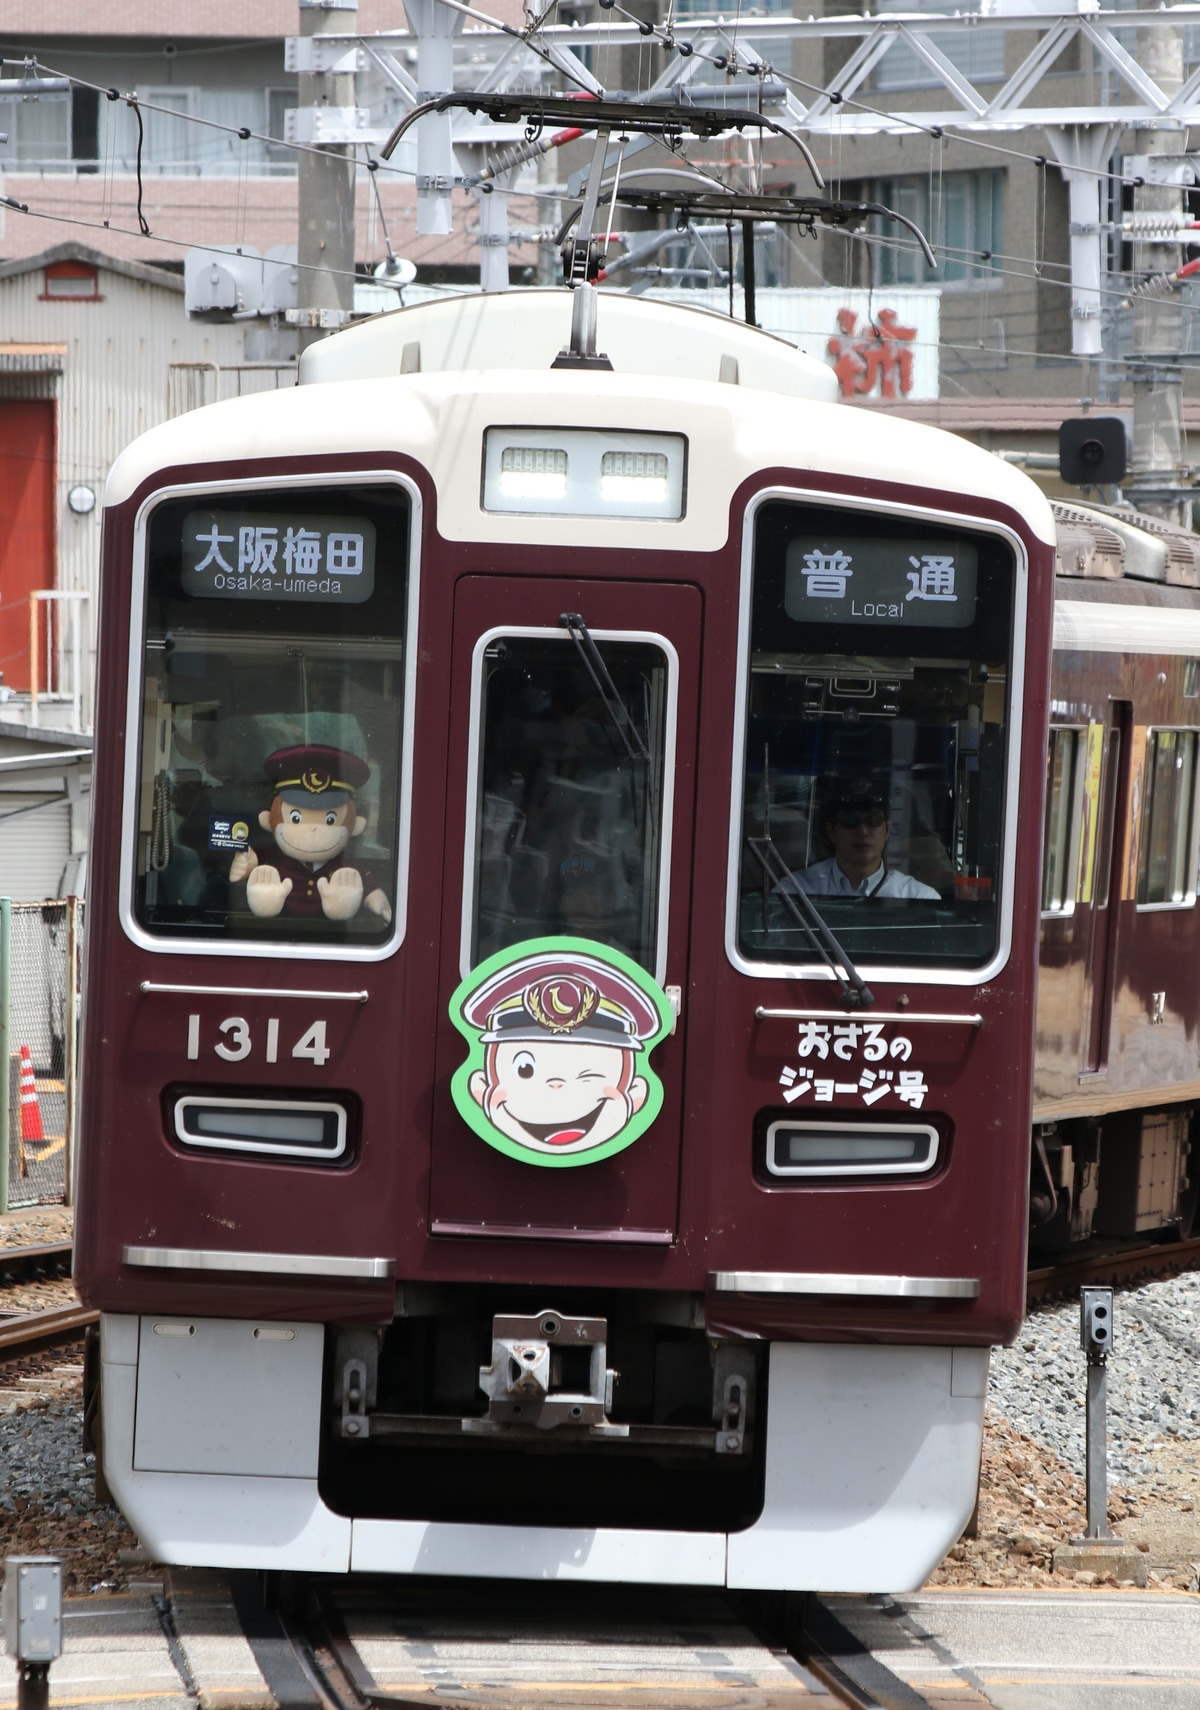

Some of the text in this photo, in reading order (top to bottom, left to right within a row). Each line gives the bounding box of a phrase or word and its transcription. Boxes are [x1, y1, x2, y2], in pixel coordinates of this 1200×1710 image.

[194, 524, 363, 575] 大阪梅田
[214, 573, 342, 594] Osaka-umeda
[801, 549, 958, 601] 普通
[851, 600, 904, 618] Local
[187, 1014, 330, 1065] 1314
[798, 1021, 912, 1062] おさるの
[779, 1065, 929, 1109] ジョージ号
